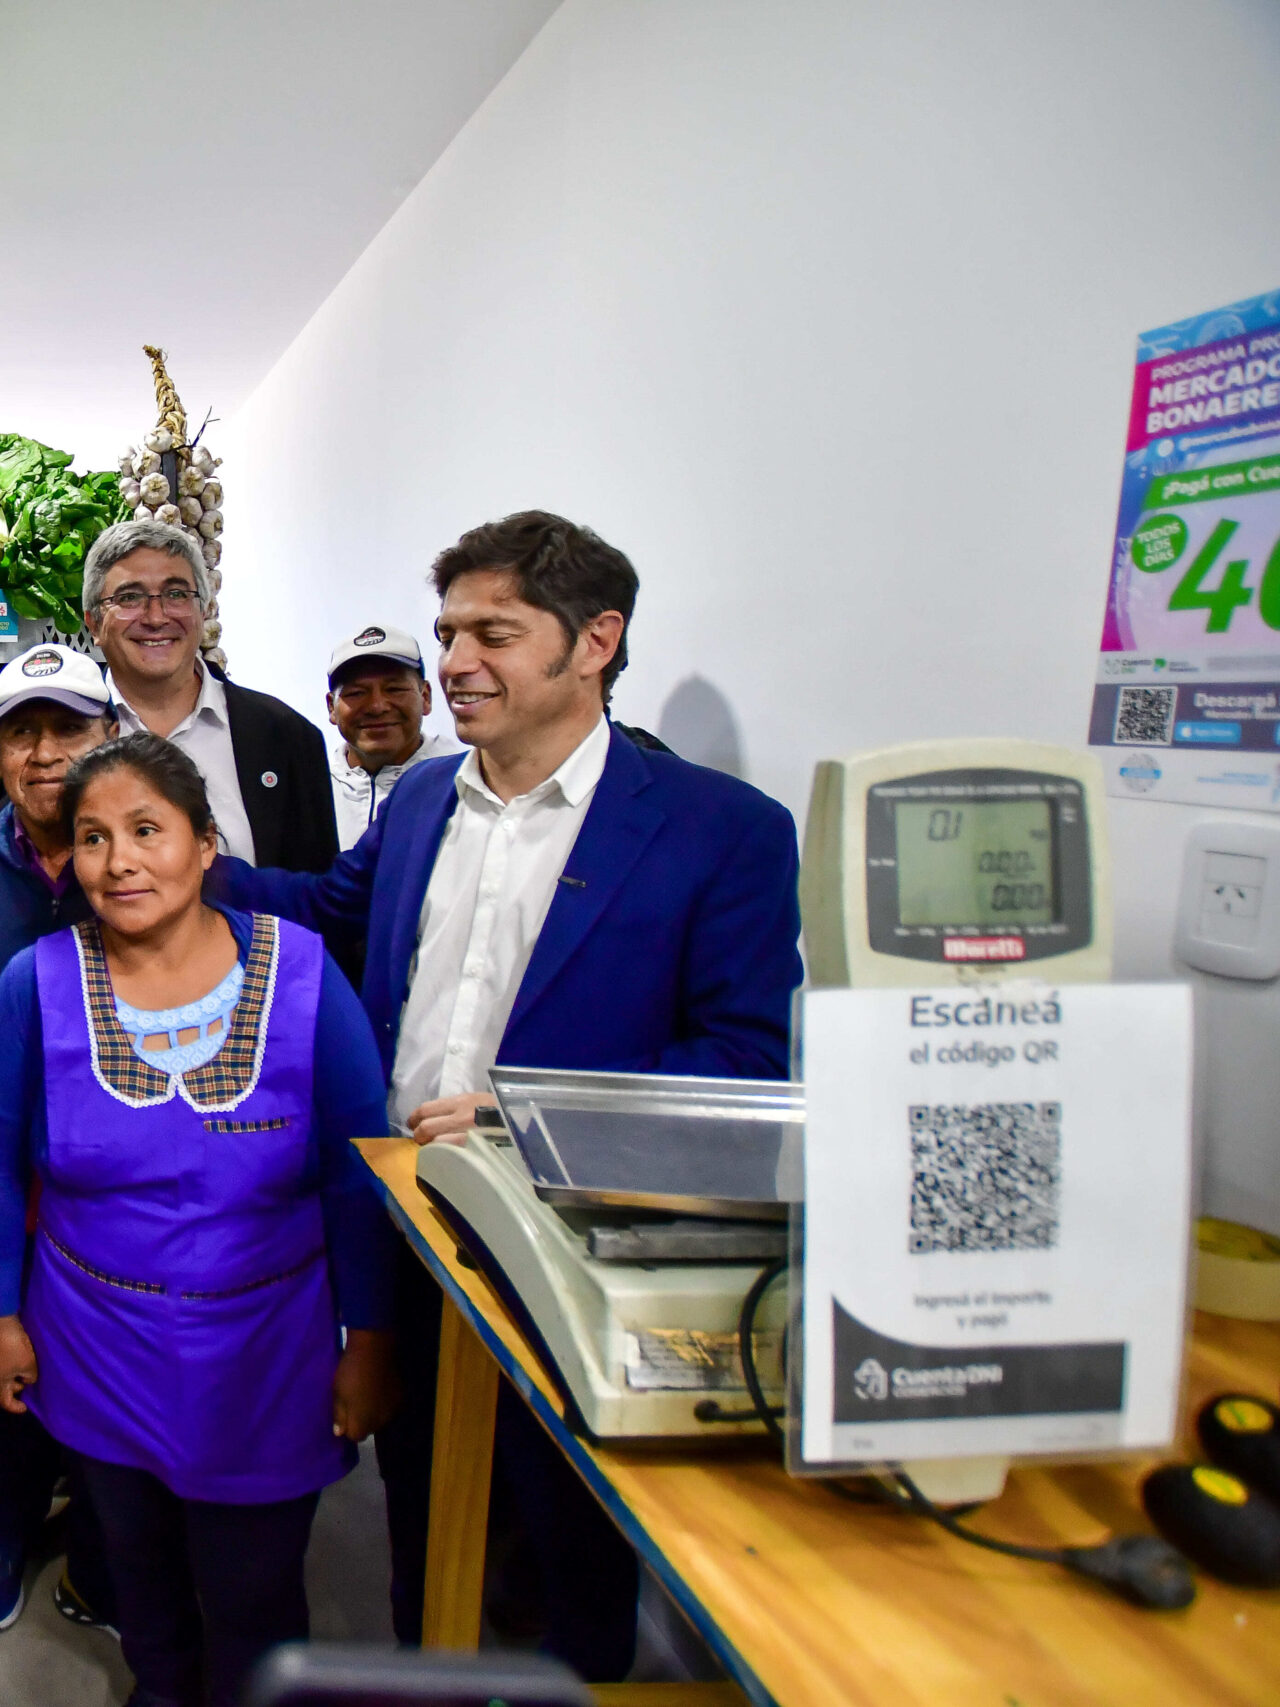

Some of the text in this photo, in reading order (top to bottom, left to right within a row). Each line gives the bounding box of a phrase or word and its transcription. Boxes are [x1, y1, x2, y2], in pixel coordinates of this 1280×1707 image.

[1151, 344, 1246, 381] PROGRAMA
[1213, 473, 1245, 488] con
[1137, 522, 1180, 543] TODOS
[1146, 538, 1171, 553] LOS
[910, 1040, 1059, 1067] el código QR
[974, 1291, 989, 1305] el
